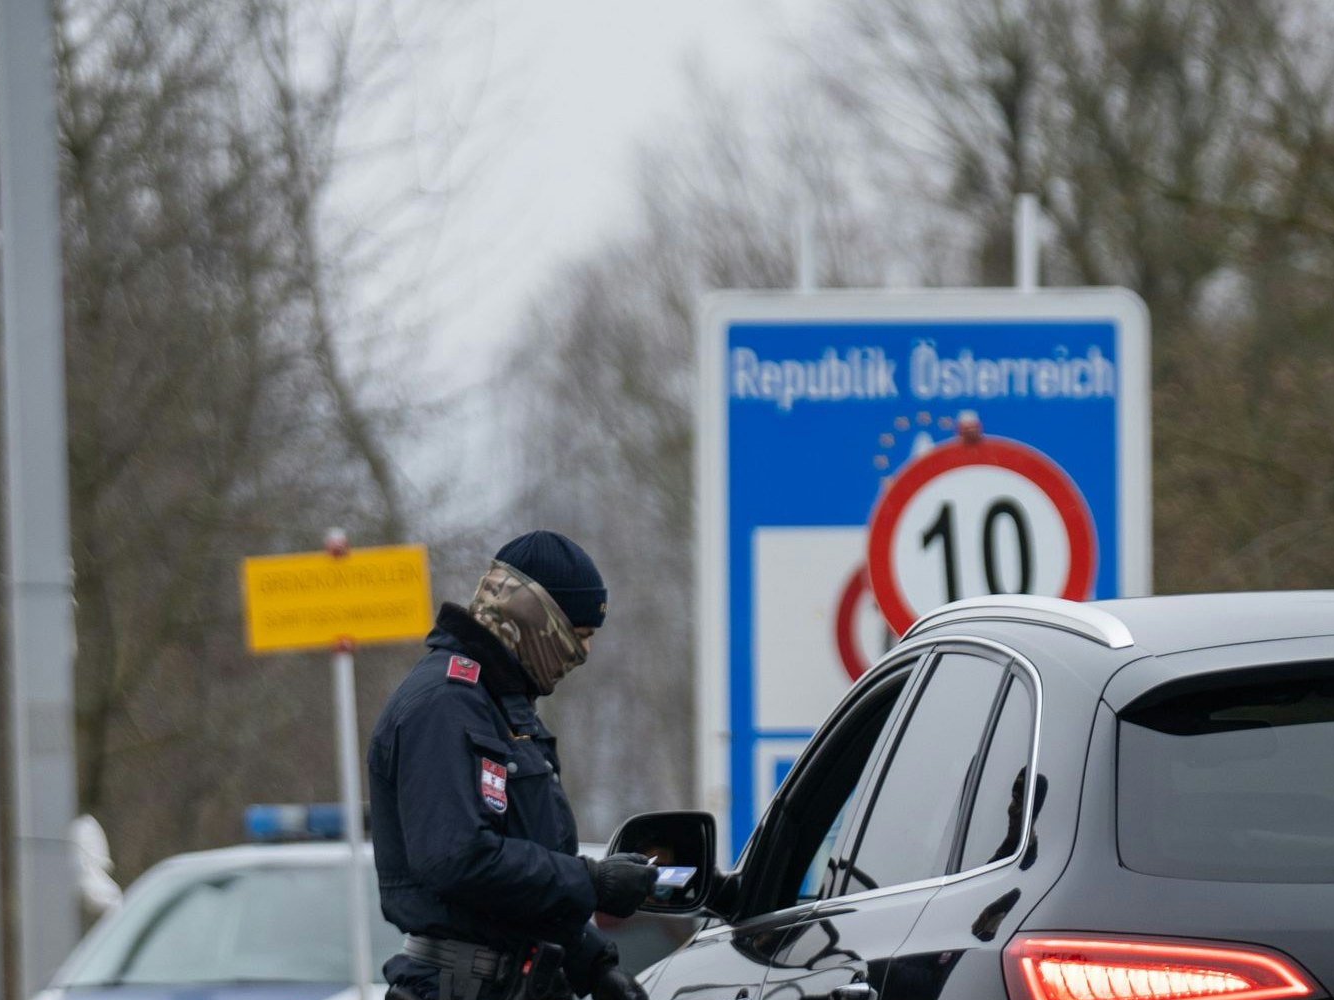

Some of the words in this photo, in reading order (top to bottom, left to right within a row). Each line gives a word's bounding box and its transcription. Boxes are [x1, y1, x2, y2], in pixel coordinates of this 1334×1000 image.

[733, 346, 899, 412] Republik
[910, 338, 1116, 400] Österreich
[920, 495, 1034, 602] 10
